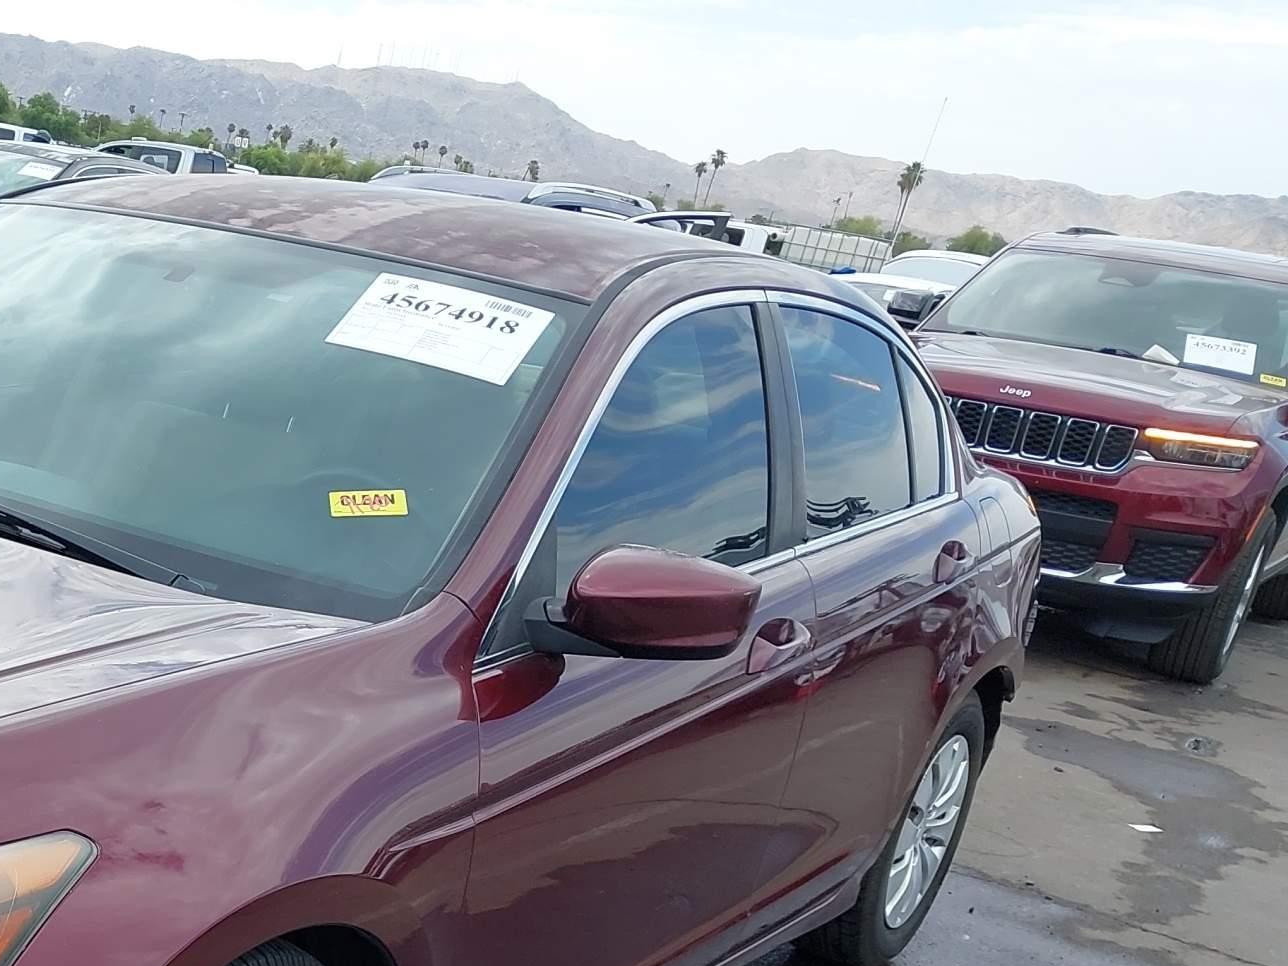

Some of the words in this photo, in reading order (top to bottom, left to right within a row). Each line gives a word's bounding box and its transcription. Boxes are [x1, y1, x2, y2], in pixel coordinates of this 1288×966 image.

[380, 292, 520, 335] 45674918
[999, 385, 1032, 398] Jeep
[340, 494, 395, 507] CLEAN
